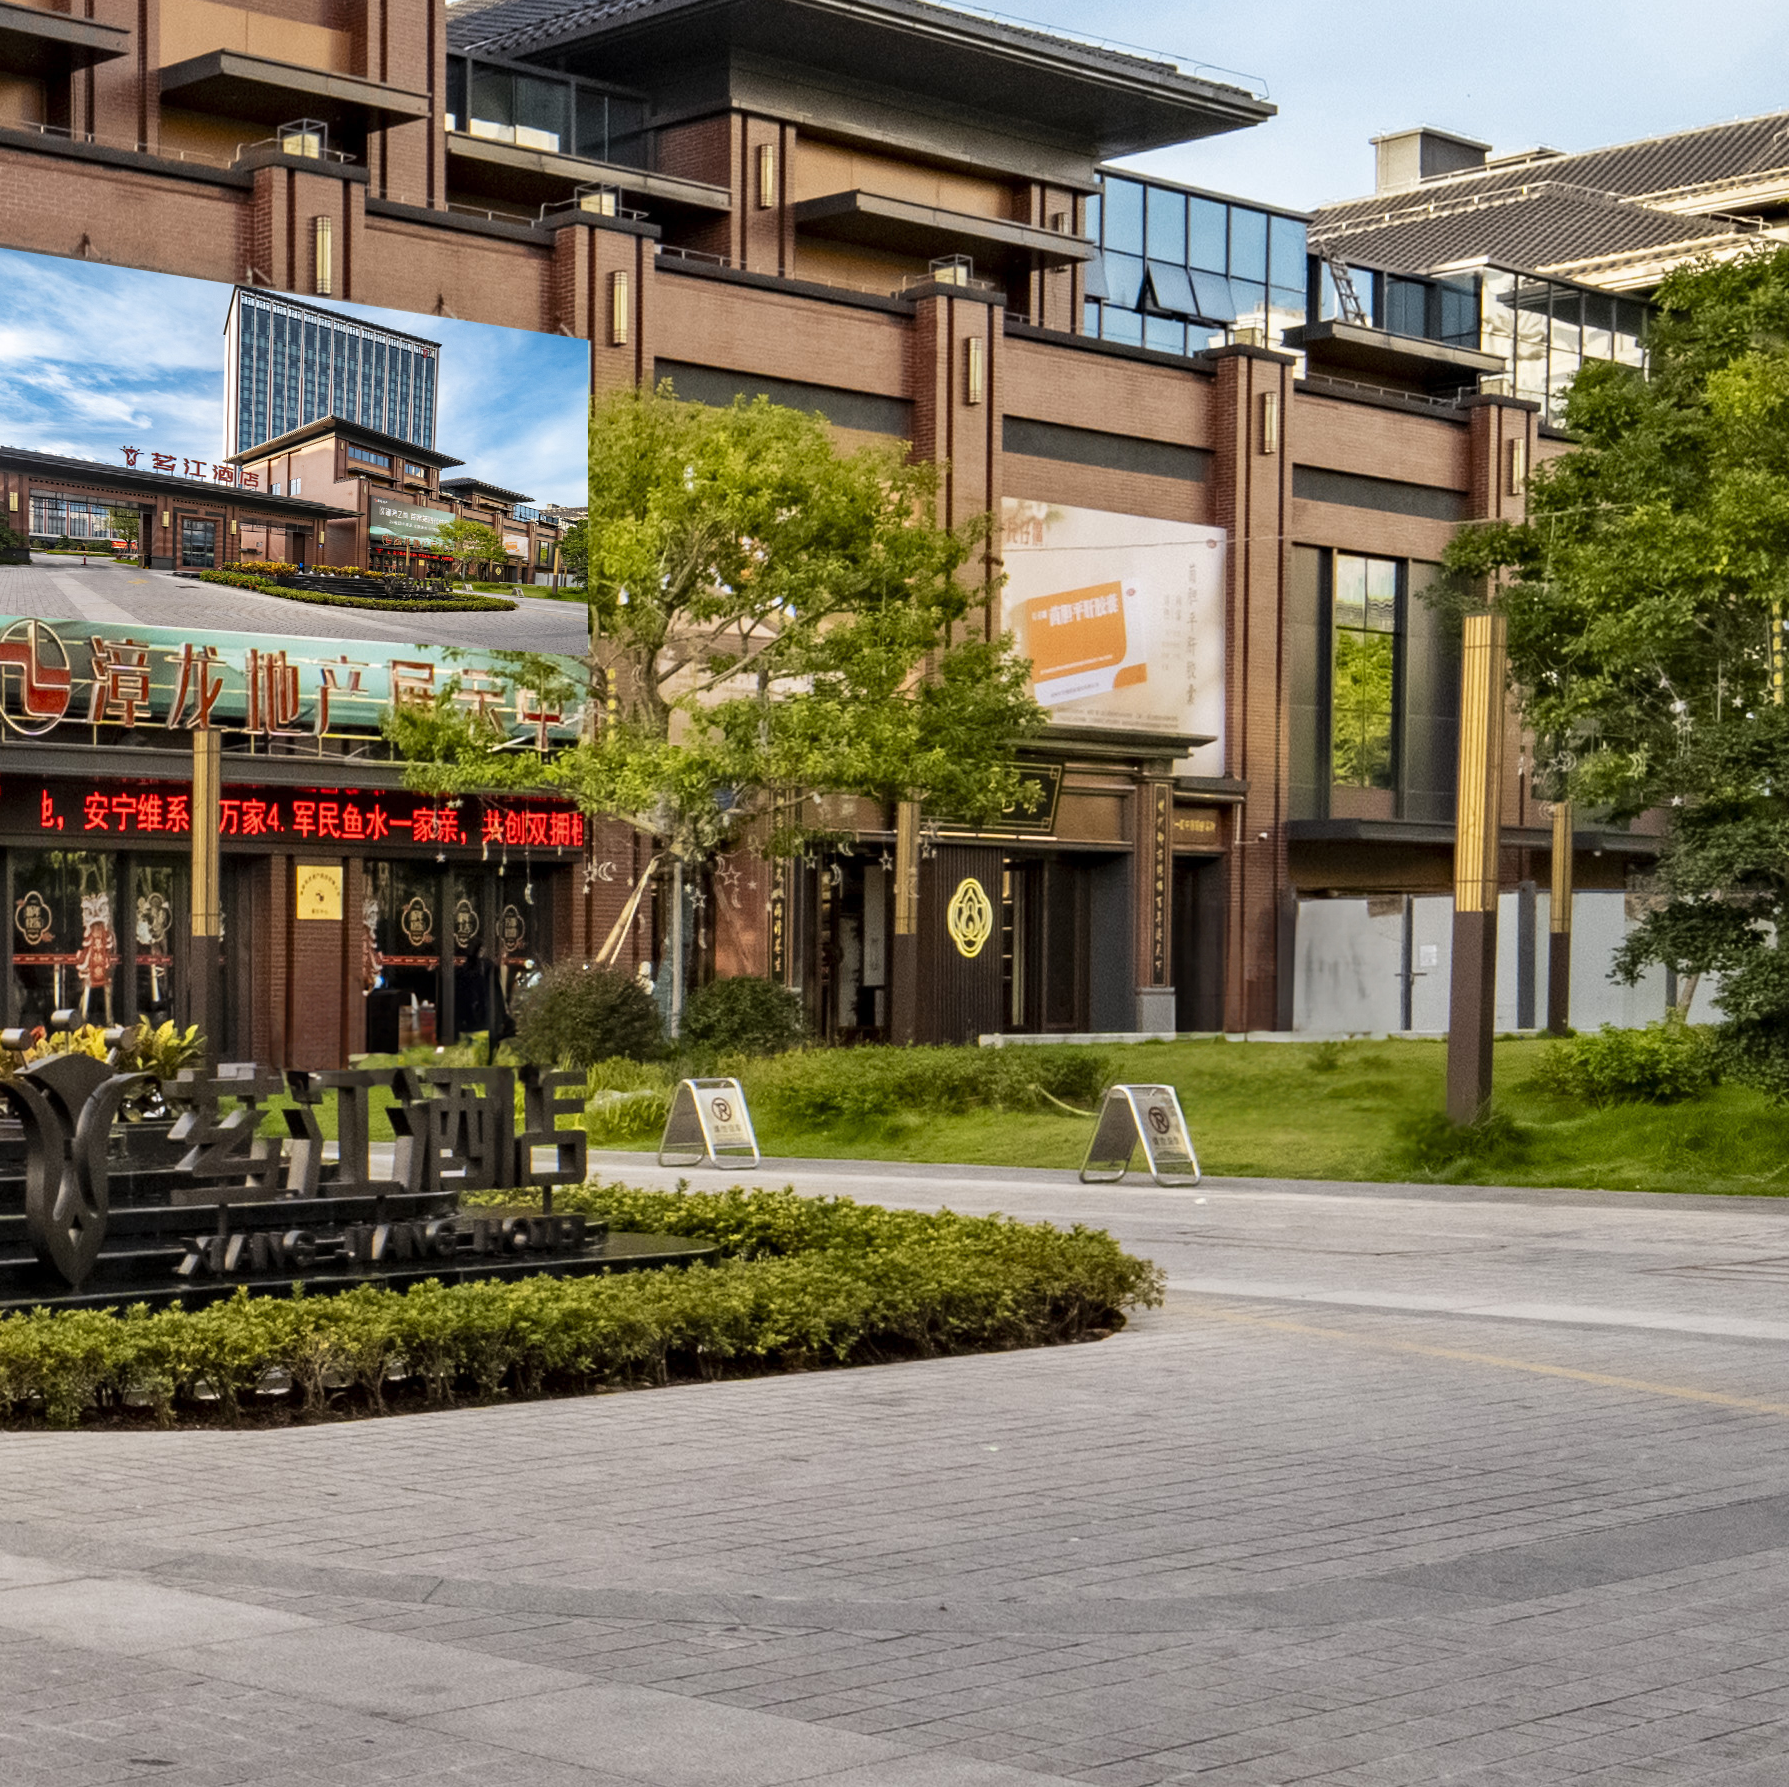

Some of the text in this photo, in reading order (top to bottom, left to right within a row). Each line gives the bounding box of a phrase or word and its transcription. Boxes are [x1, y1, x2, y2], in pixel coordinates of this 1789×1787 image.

[88, 634, 609, 756] 漳龙地产展示中
[166, 1062, 587, 1206] 芗江酒店
[169, 1229, 317, 1276] XIANG
